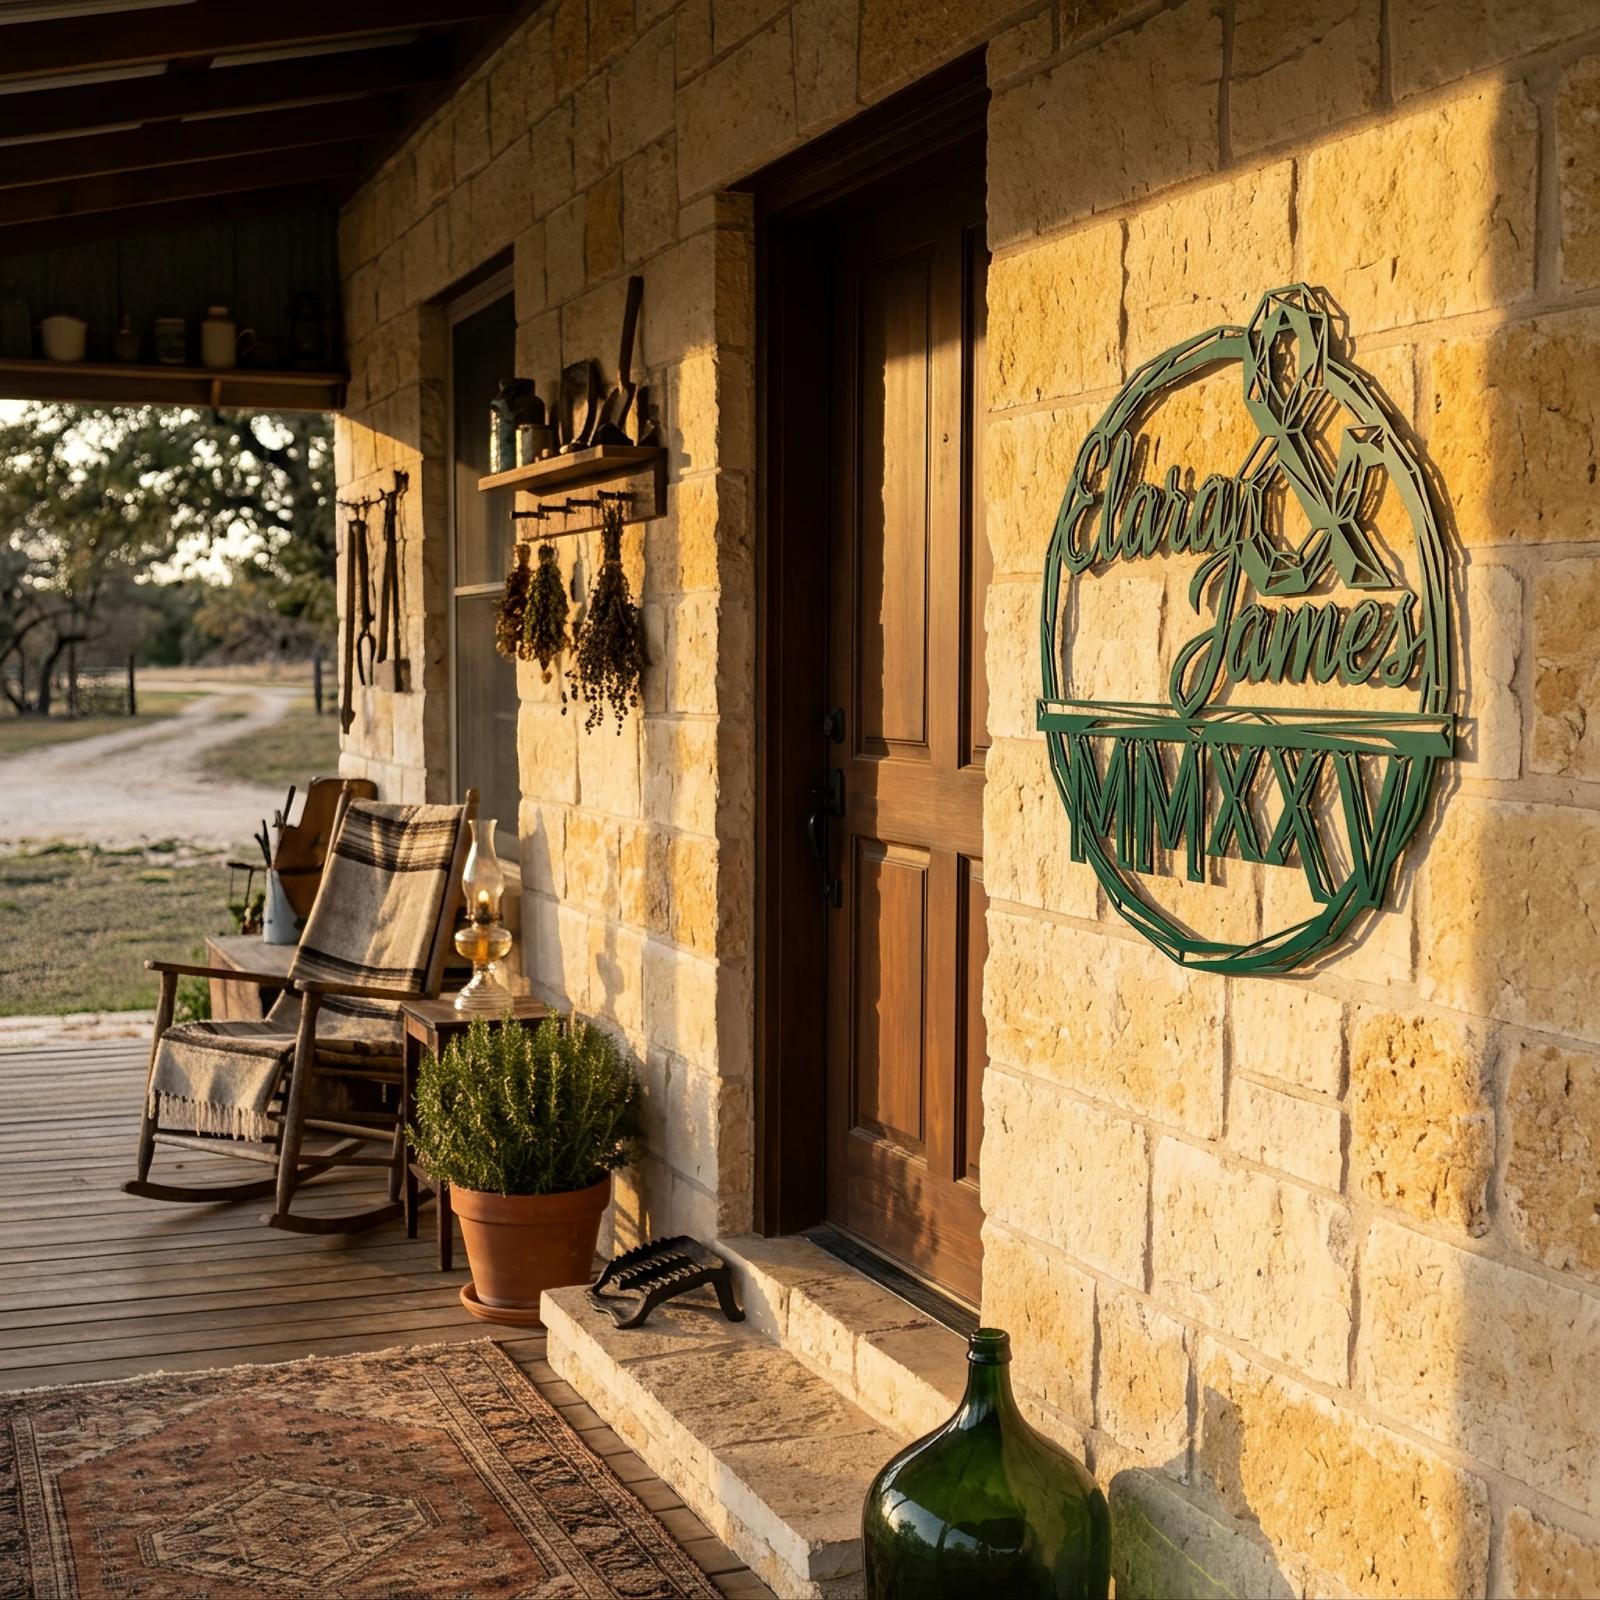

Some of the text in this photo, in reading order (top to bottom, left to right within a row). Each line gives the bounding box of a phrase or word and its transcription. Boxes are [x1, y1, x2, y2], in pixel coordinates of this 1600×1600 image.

[1062, 430, 1236, 575] Elara
[1169, 543, 1424, 719] James
[1071, 732, 1414, 909] MMXXV
